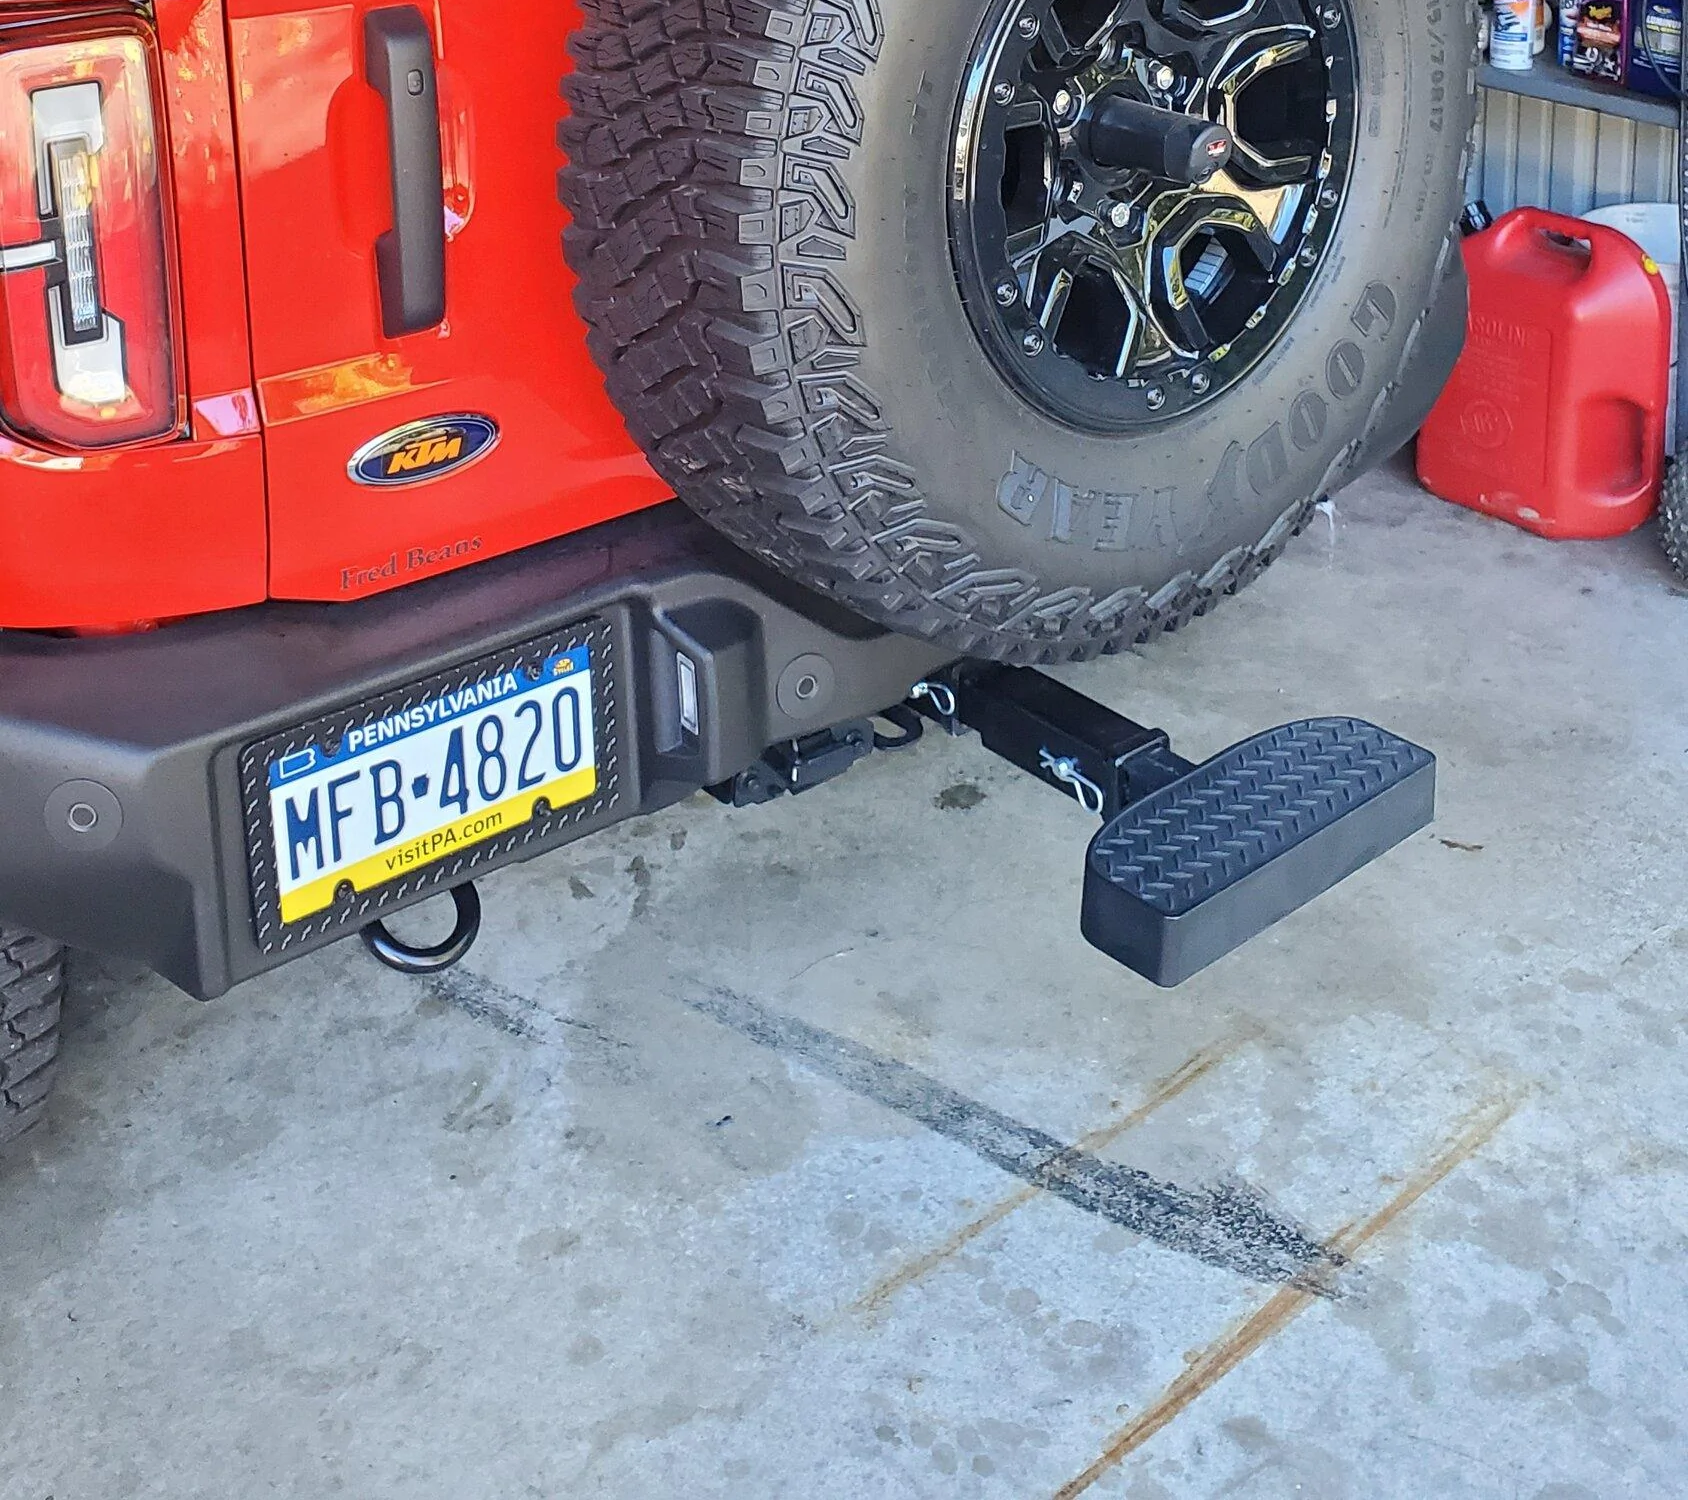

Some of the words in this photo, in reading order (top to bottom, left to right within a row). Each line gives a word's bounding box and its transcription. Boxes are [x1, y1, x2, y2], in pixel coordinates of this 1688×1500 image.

[387, 436, 463, 475] KTM
[340, 553, 397, 591] Fred
[406, 536, 485, 571] Beans
[348, 672, 518, 752] PENNSYLVANIA
[385, 810, 504, 871] visitPA.com
